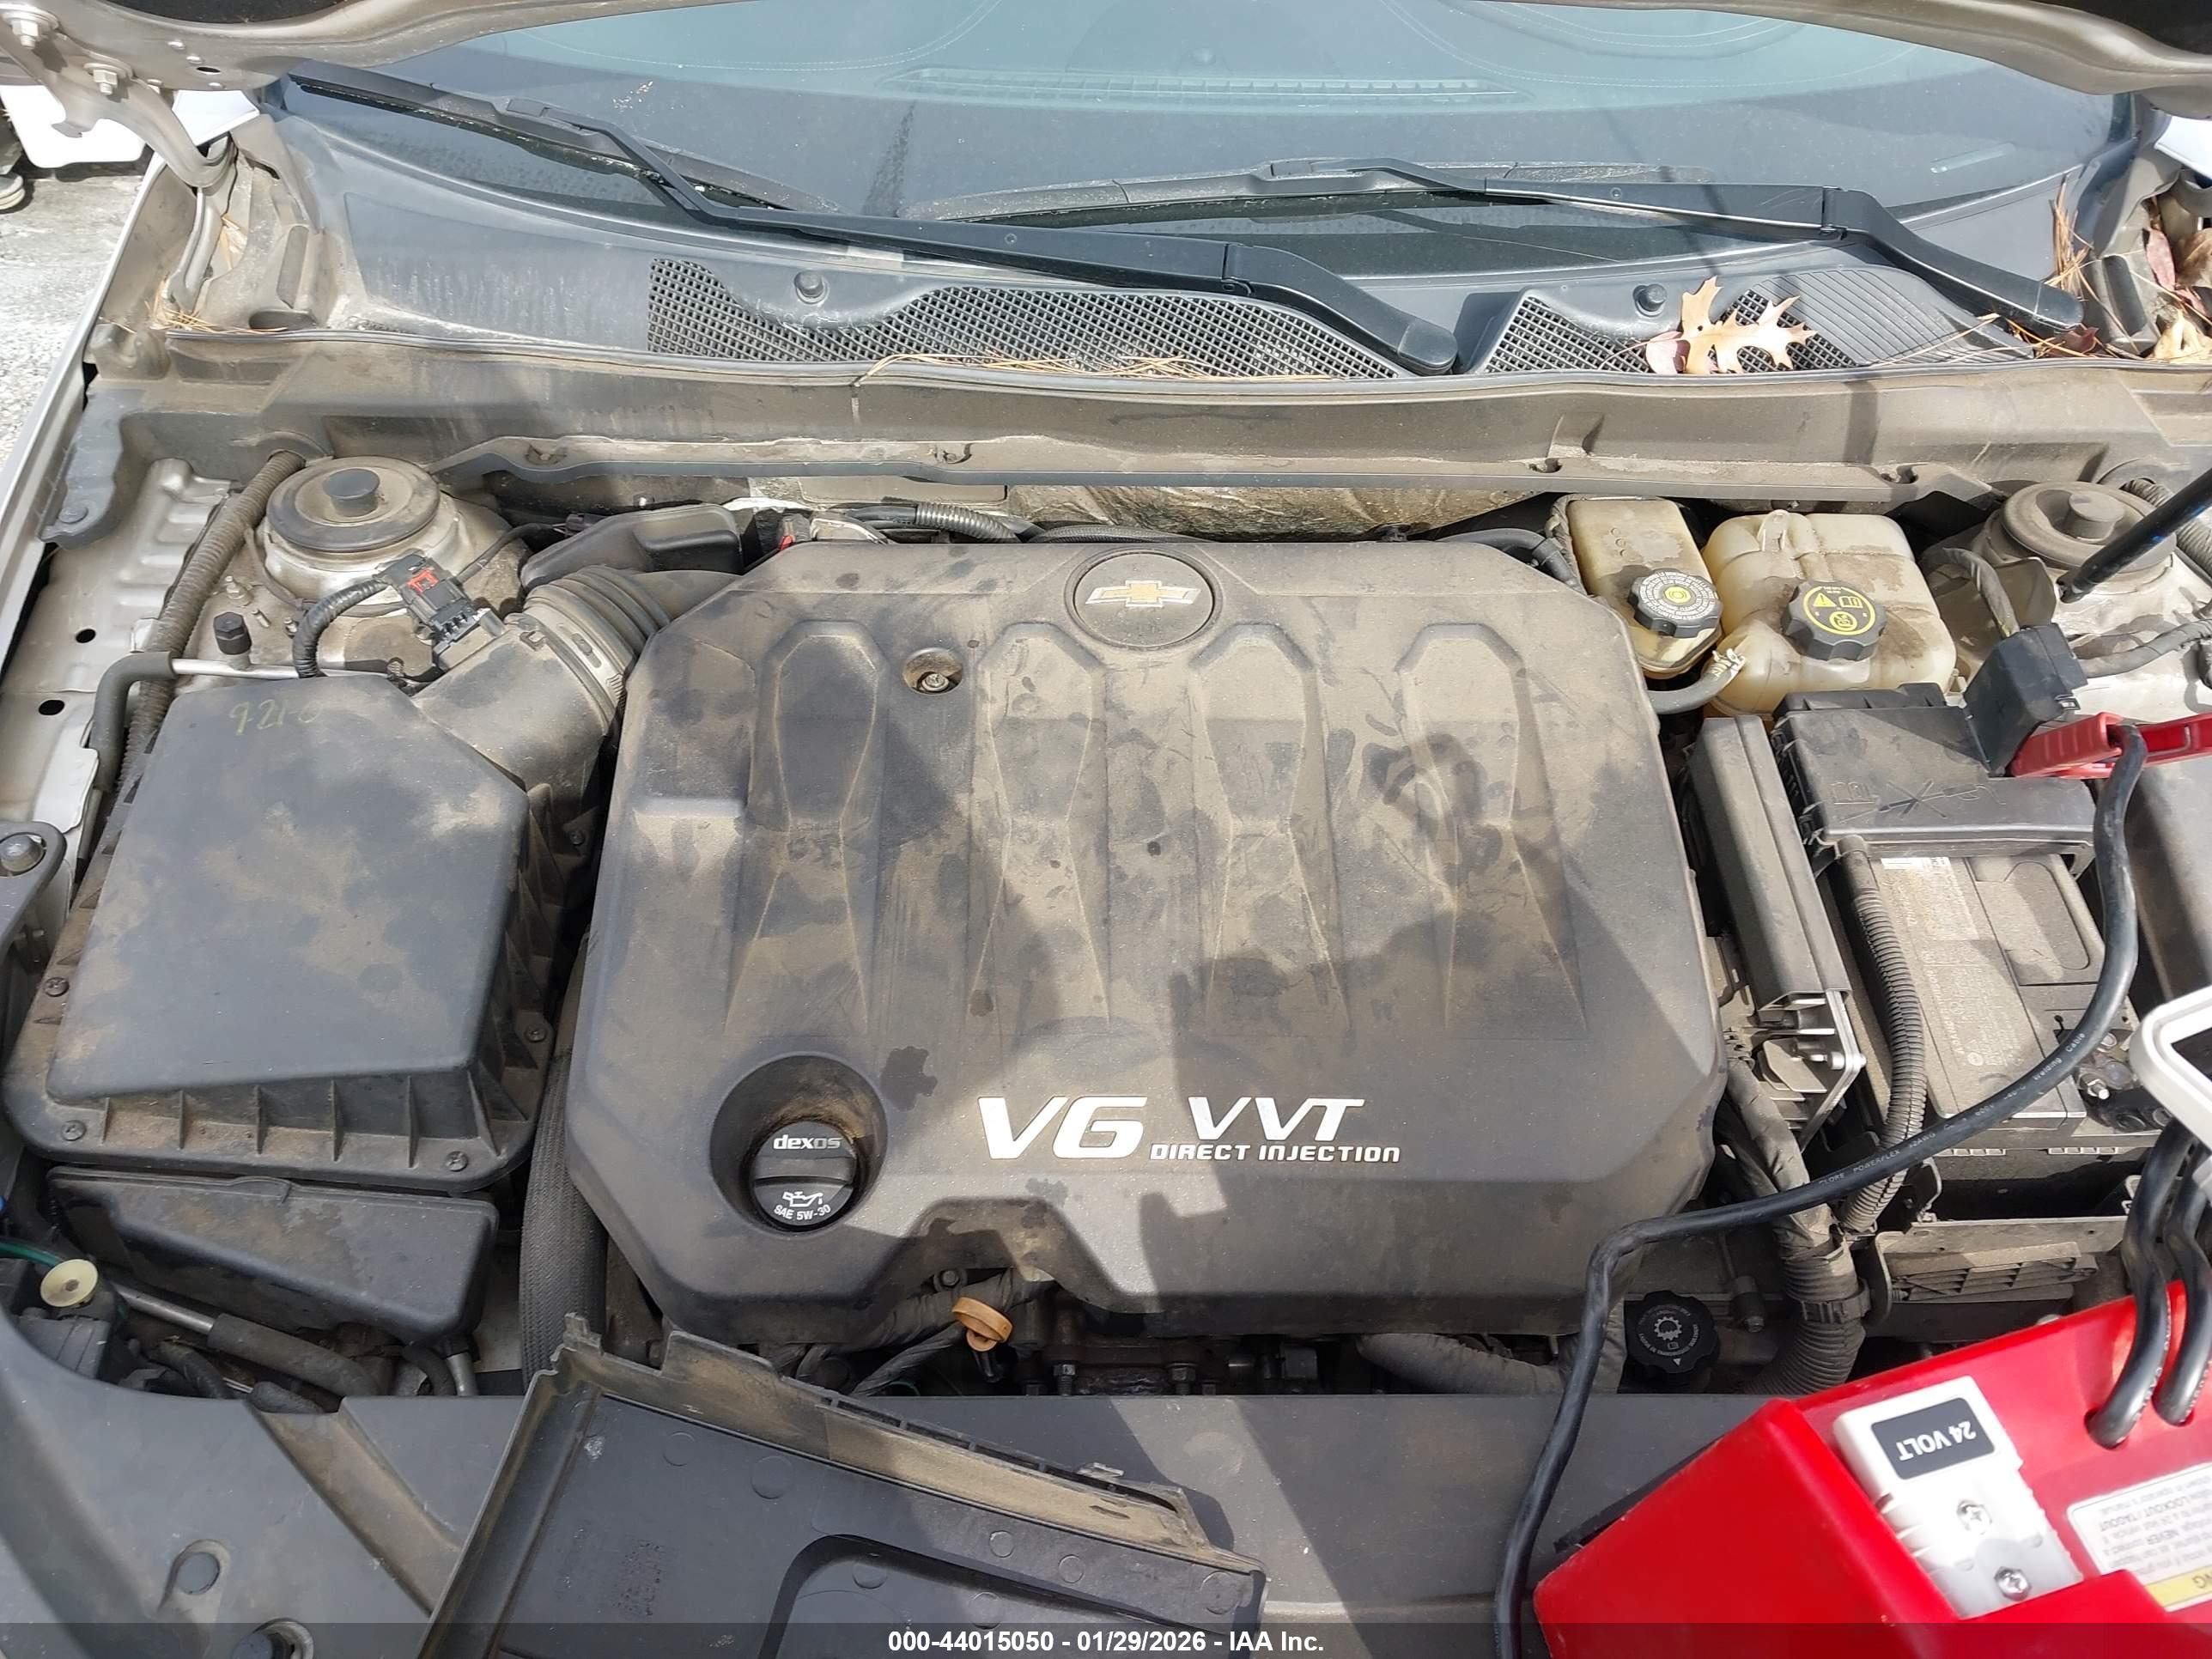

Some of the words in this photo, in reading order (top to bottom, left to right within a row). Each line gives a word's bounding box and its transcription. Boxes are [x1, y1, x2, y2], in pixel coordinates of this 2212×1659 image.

[2065, 1032, 2086, 1054] Cable
[977, 1095, 1149, 1160] V6
[1188, 1096, 1365, 1142] VVT
[773, 1133, 845, 1150] dexos
[1149, 1143, 1251, 1161] DIRECT
[1258, 1144, 1401, 1164] INJECTION
[773, 1204, 795, 1220] SAE
[796, 1204, 832, 1221] 5W-30
[1948, 1420, 1978, 1443] 24
[1895, 1430, 1953, 1462] VOLT
